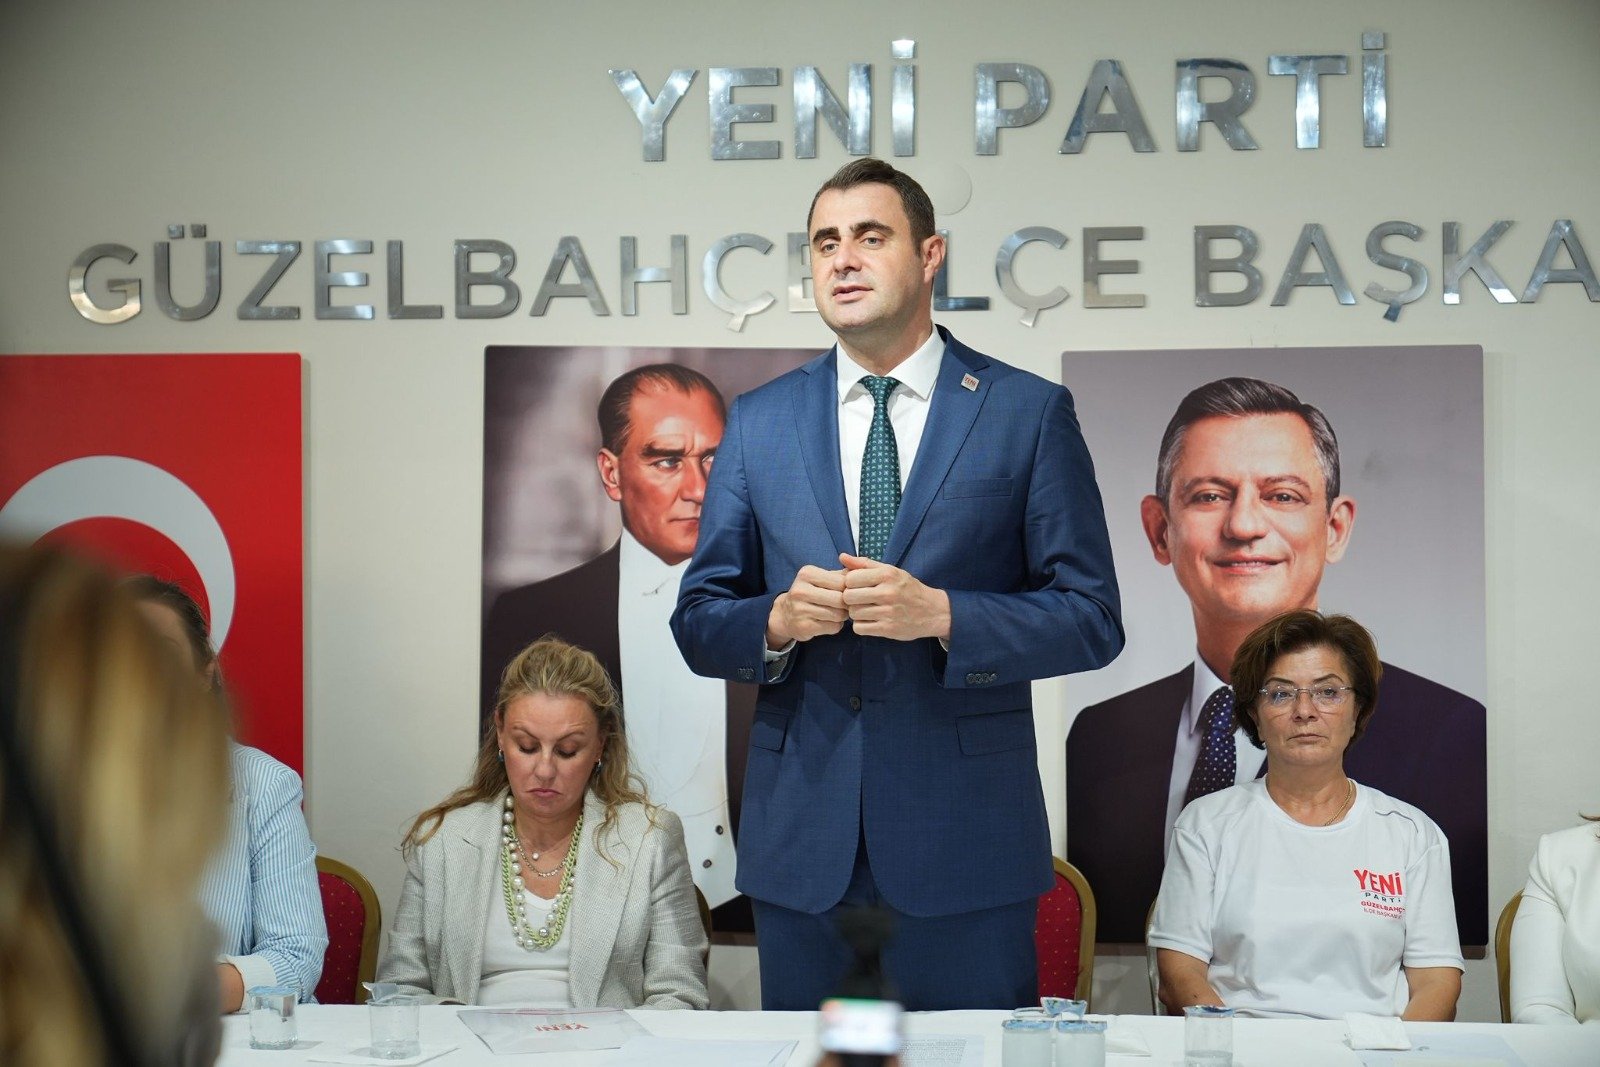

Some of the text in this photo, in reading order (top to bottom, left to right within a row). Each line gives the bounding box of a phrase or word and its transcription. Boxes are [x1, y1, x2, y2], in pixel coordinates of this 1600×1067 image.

[608, 32, 1389, 161] YENİ PARTİ
[933, 226, 1146, 328] LÇE
[1194, 219, 1600, 323] BAŞKA
[1353, 869, 1403, 895] YENİ
[1360, 900, 1406, 914] GÜZELBAHÇ
